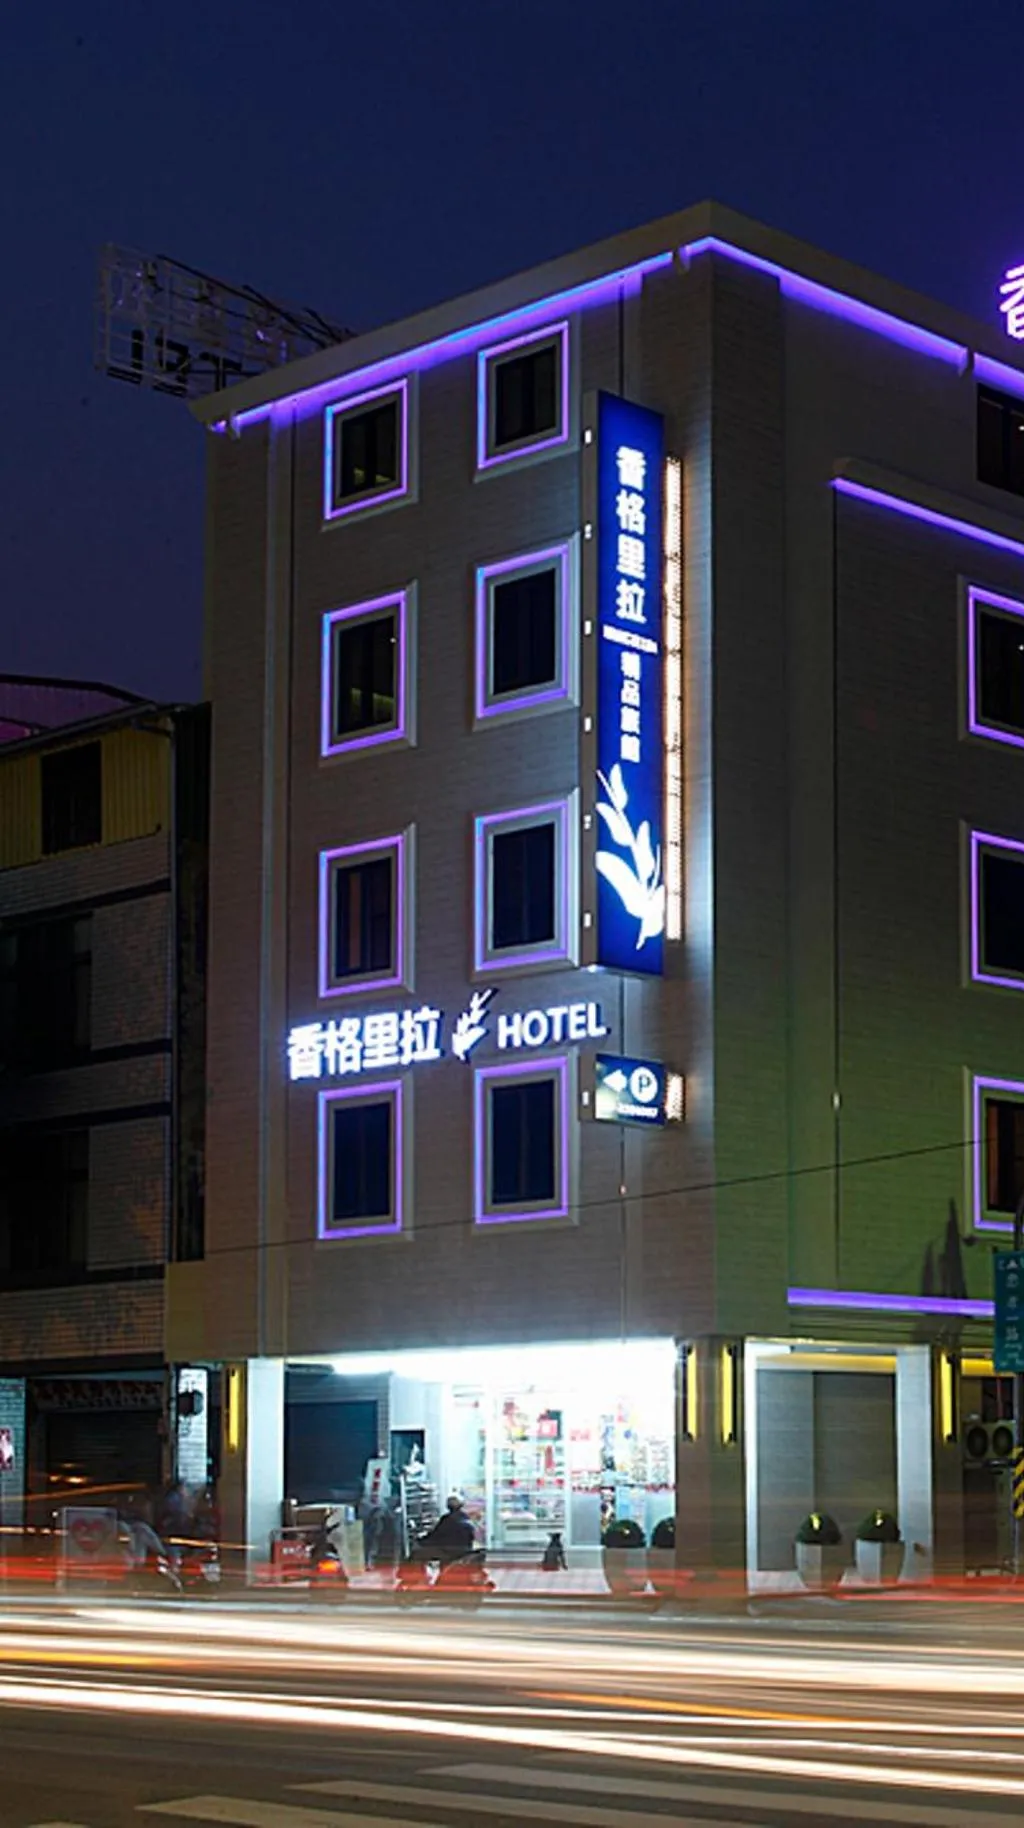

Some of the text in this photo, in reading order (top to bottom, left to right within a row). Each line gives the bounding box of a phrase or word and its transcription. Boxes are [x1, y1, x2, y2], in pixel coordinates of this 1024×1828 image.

[615, 446, 647, 623] 香格里拉
[287, 1003, 606, 1080] 香格里拉 HOTEL
